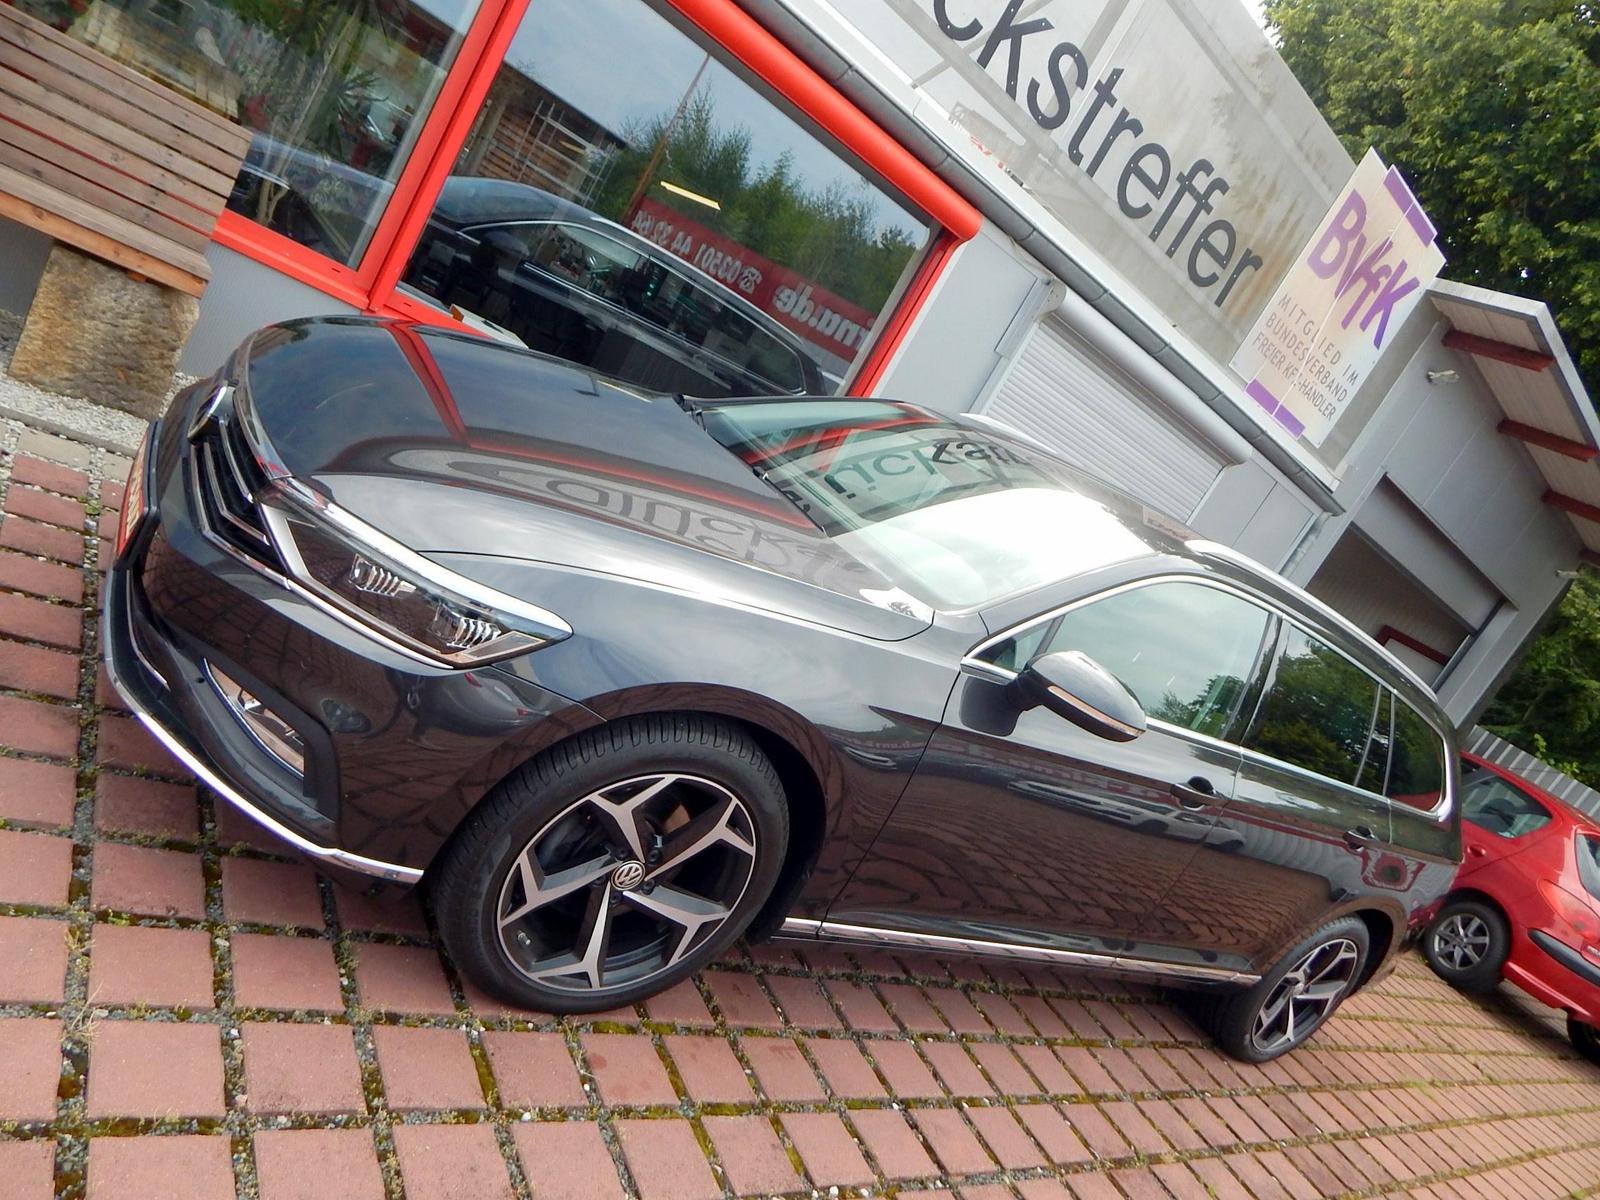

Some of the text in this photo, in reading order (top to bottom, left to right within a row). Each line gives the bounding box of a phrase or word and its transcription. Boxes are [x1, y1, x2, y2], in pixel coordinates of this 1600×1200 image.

[1252, 331, 1287, 371] FREIER
[1265, 312, 1348, 403] BUNDESVERBAND
[1277, 293, 1359, 388] MITGLIED IM
